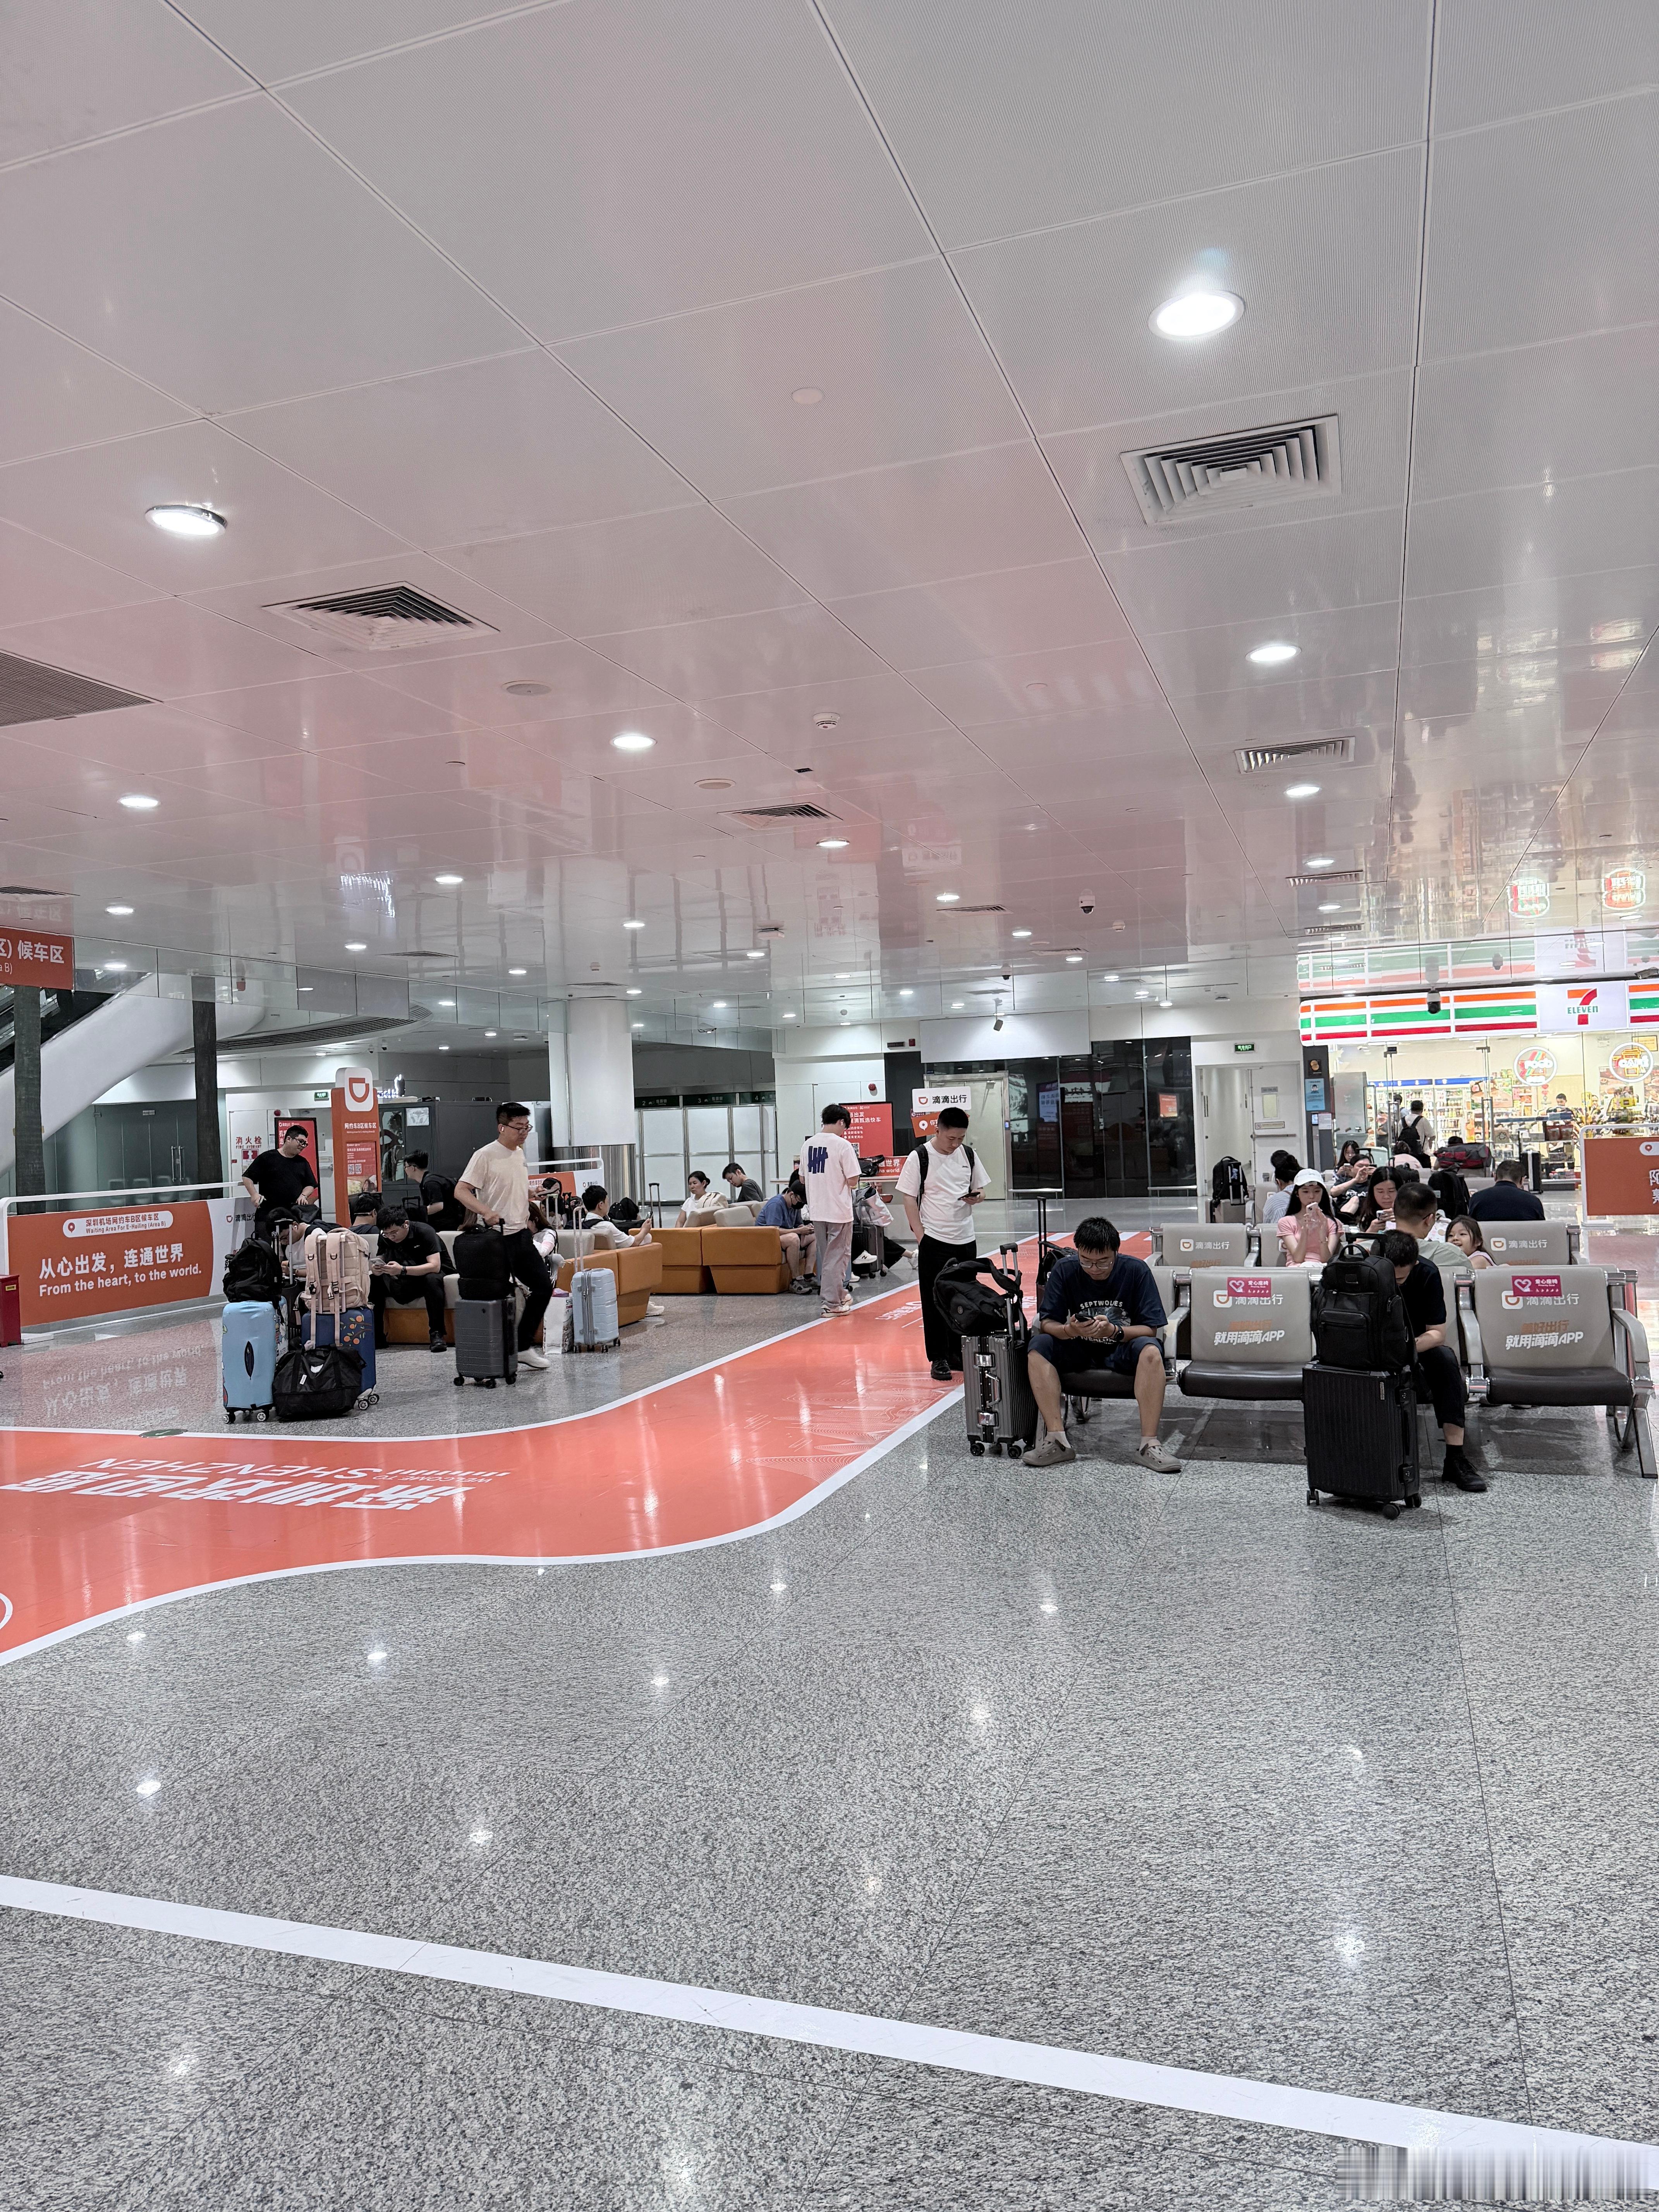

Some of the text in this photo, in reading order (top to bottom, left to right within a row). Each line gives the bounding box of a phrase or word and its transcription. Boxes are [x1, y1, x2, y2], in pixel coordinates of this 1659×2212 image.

[17, 940, 64, 963] 候车区
[5, 963, 12, 974] B)
[1567, 988, 1597, 1025] 7
[933, 1095, 967, 1104] 滴滴出行
[236, 1136, 261, 1144] 消火栓
[86, 1213, 159, 1227] 深圳机场网约车B区候车区
[1509, 1240, 1547, 1248] 滴滴出行
[40, 1263, 202, 1297] From the heart, to the world.
[1235, 1294, 1283, 1305] 滴滴出行
[1527, 1293, 1579, 1305] 滴滴出行
[1214, 1330, 1285, 1345] 就用滴滴APP
[1506, 1332, 1583, 1350] 就用滴滴APP
[77, 1458, 383, 1479] SHENZHEN
